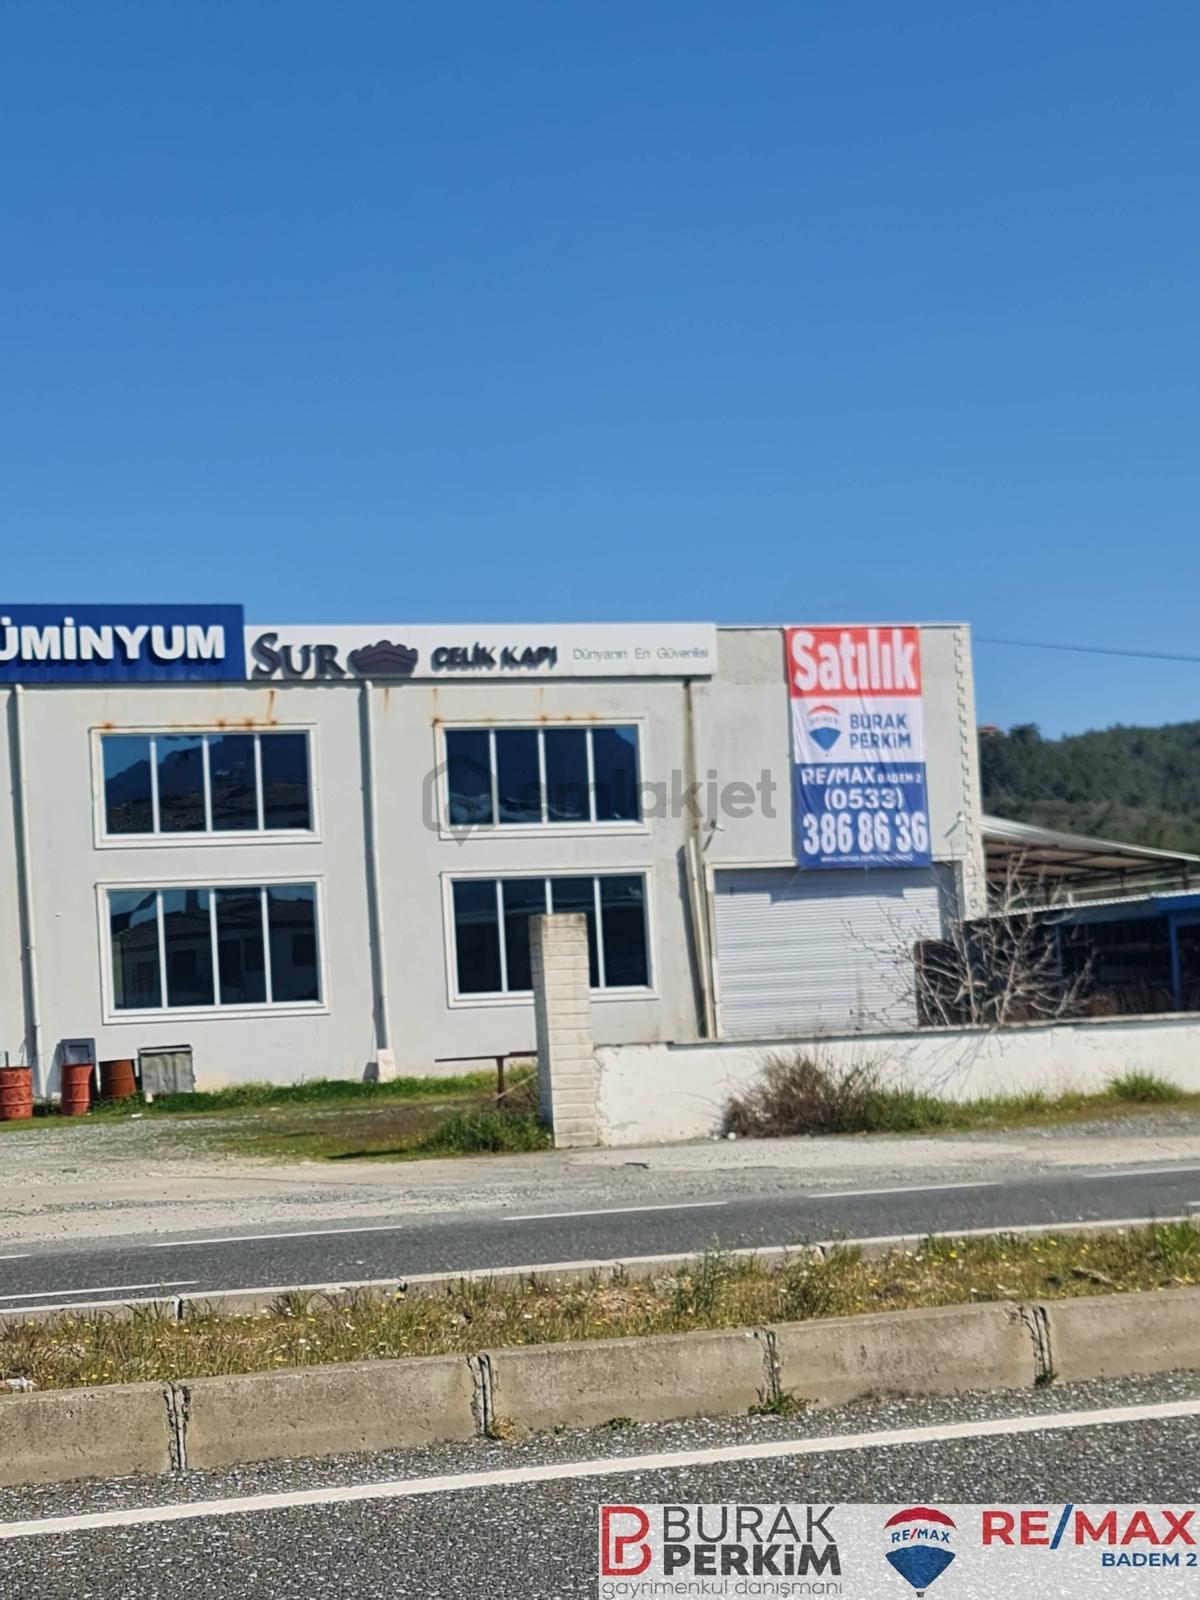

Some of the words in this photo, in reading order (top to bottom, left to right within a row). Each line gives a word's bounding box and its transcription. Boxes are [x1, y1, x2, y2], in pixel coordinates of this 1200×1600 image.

[572, 648, 628, 662] Dünyanın
[634, 647, 651, 660] En
[656, 647, 709, 660] Güvenlisi
[791, 628, 917, 691] Satılık
[850, 713, 908, 730] BURAK
[801, 766, 876, 785] RE/MAX
[824, 787, 903, 811] (0533)
[802, 812, 853, 855] 386
[857, 811, 891, 853] 86
[895, 811, 928, 853] 36
